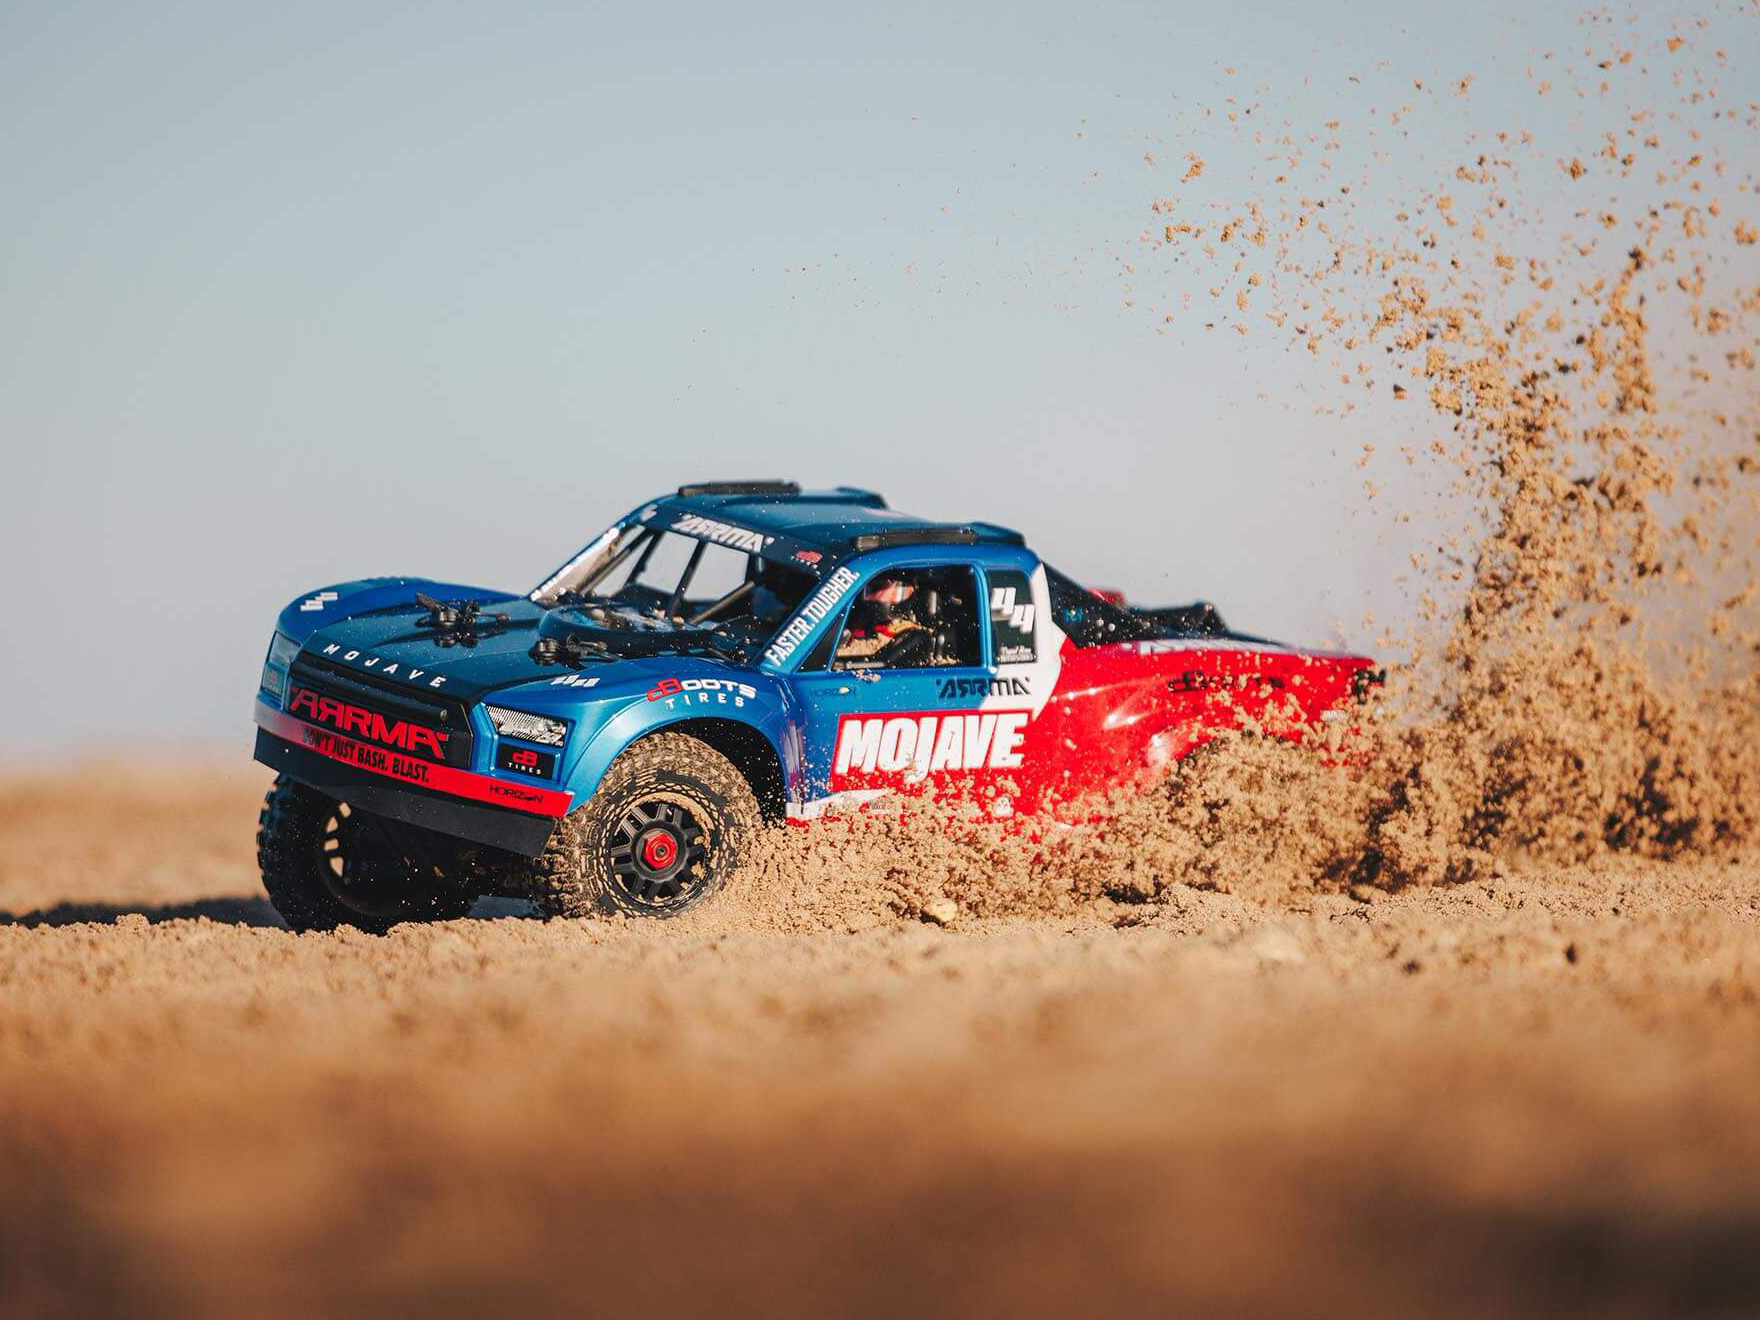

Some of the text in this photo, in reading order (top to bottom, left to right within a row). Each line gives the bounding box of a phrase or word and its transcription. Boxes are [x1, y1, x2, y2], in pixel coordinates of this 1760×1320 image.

[323, 643, 447, 688] MOJAVE
[664, 692, 745, 710] TIRES
[332, 734, 356, 761] JUST
[357, 744, 389, 770] BASH.
[392, 757, 430, 782] BLAST.
[508, 762, 542, 775] TIRES
[835, 712, 1029, 784] MOJAVE
